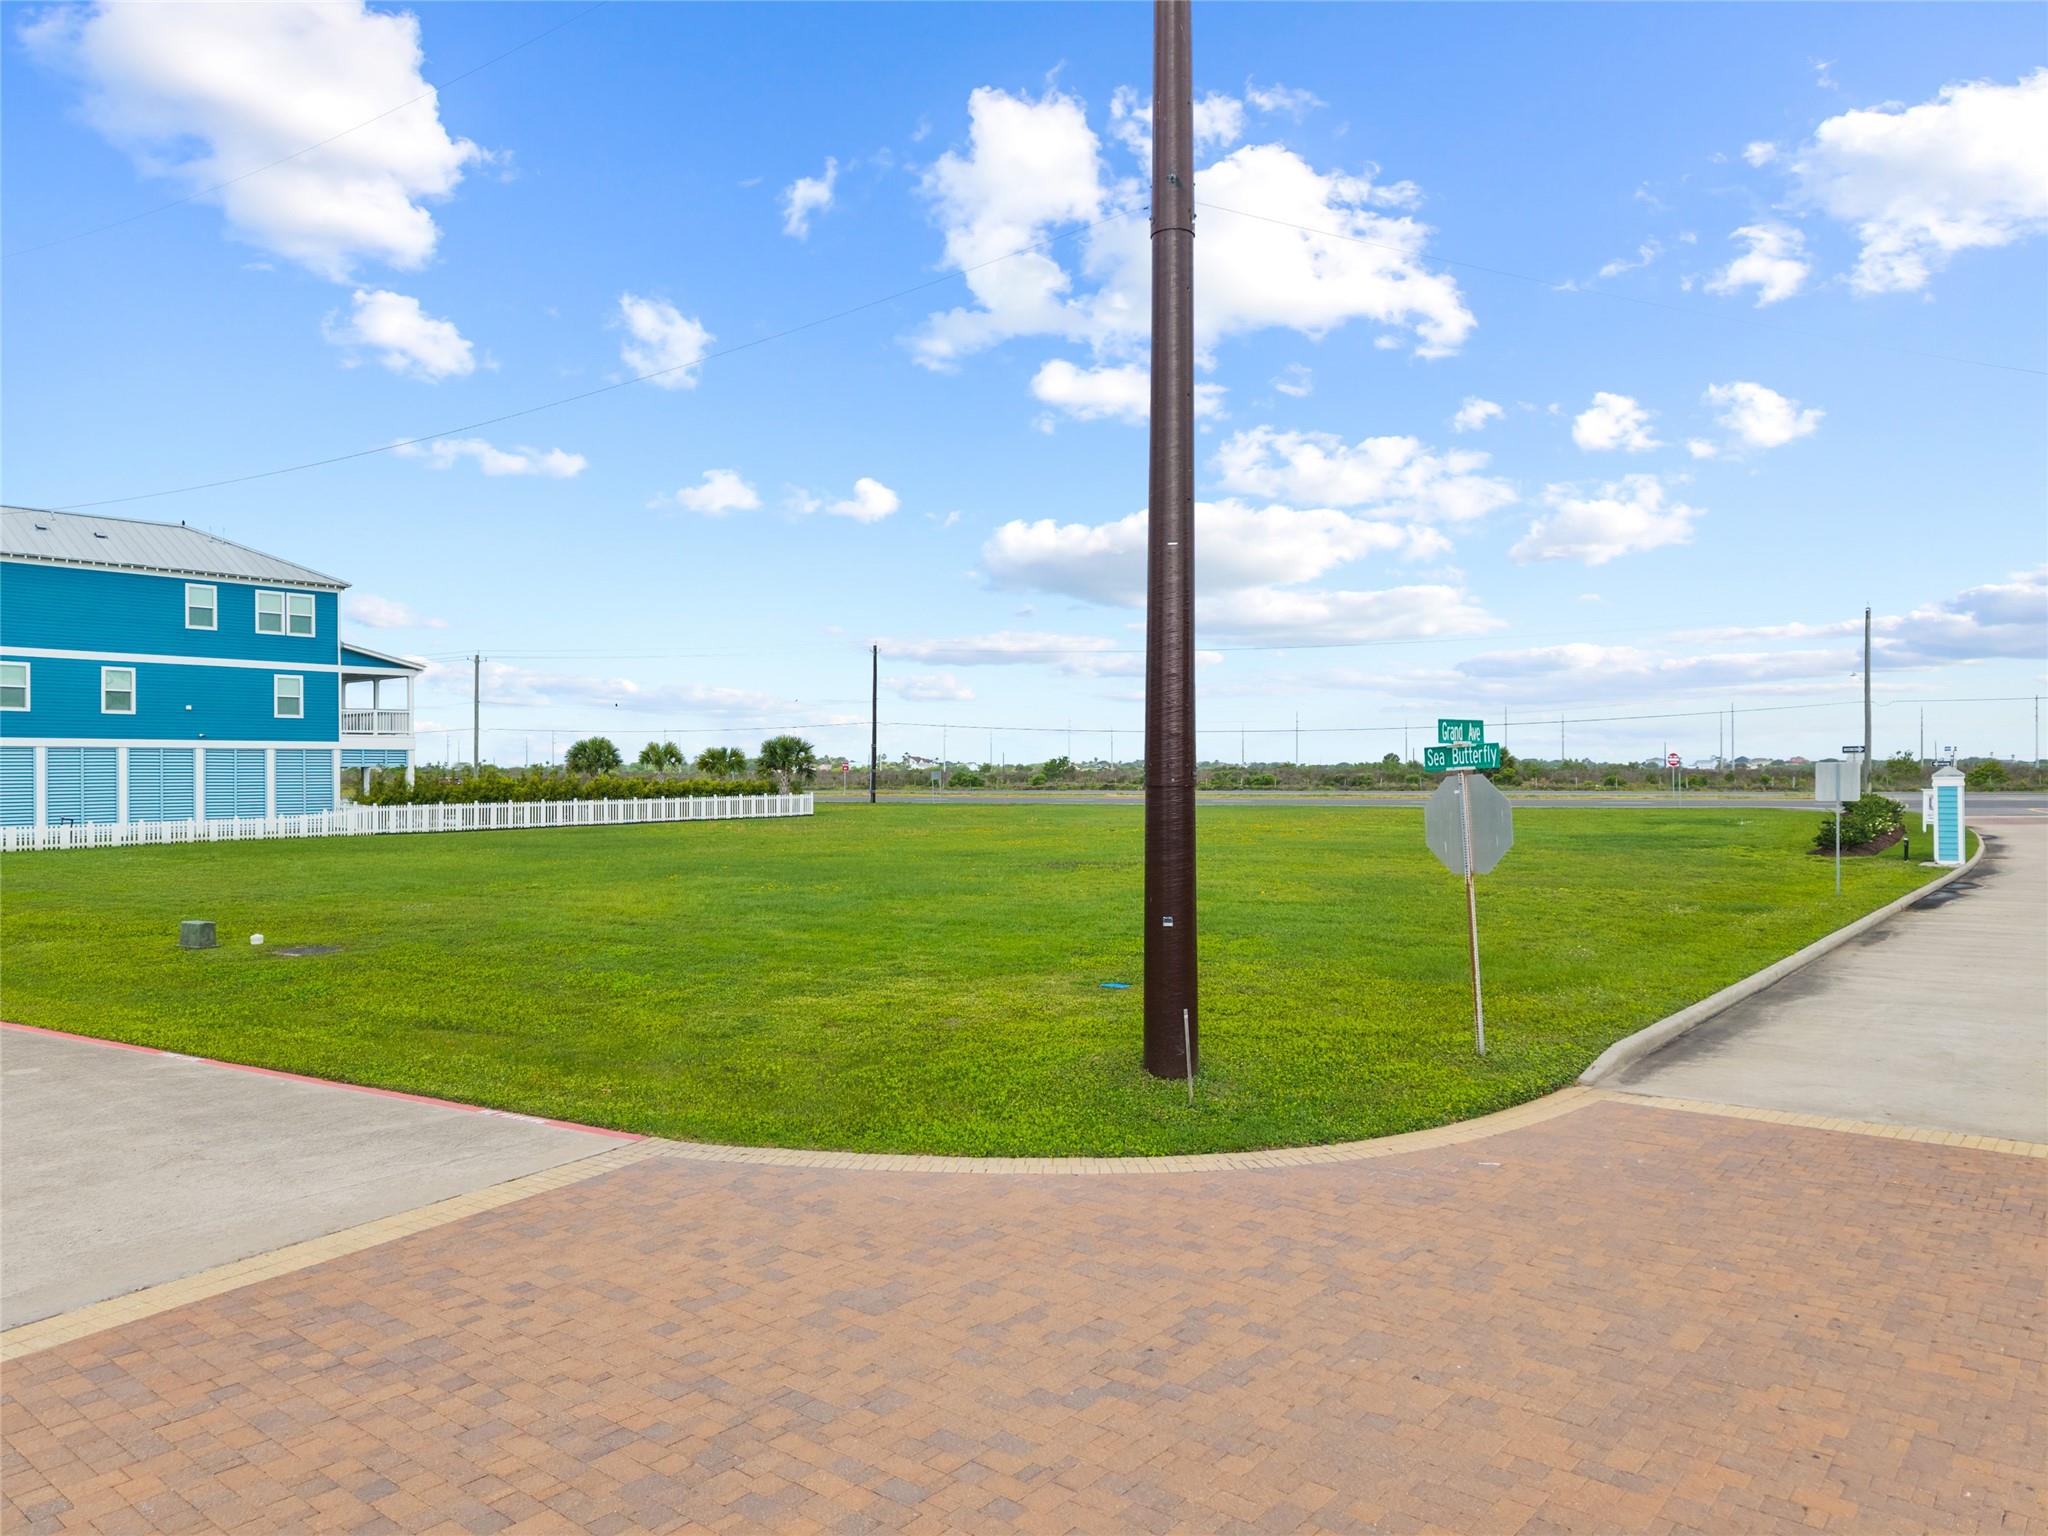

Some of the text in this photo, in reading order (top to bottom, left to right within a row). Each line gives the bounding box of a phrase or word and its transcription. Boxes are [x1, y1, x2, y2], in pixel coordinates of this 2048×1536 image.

[1442, 722, 1480, 741] Grand Ave
[1427, 747, 1497, 767] Sea Butterfly
